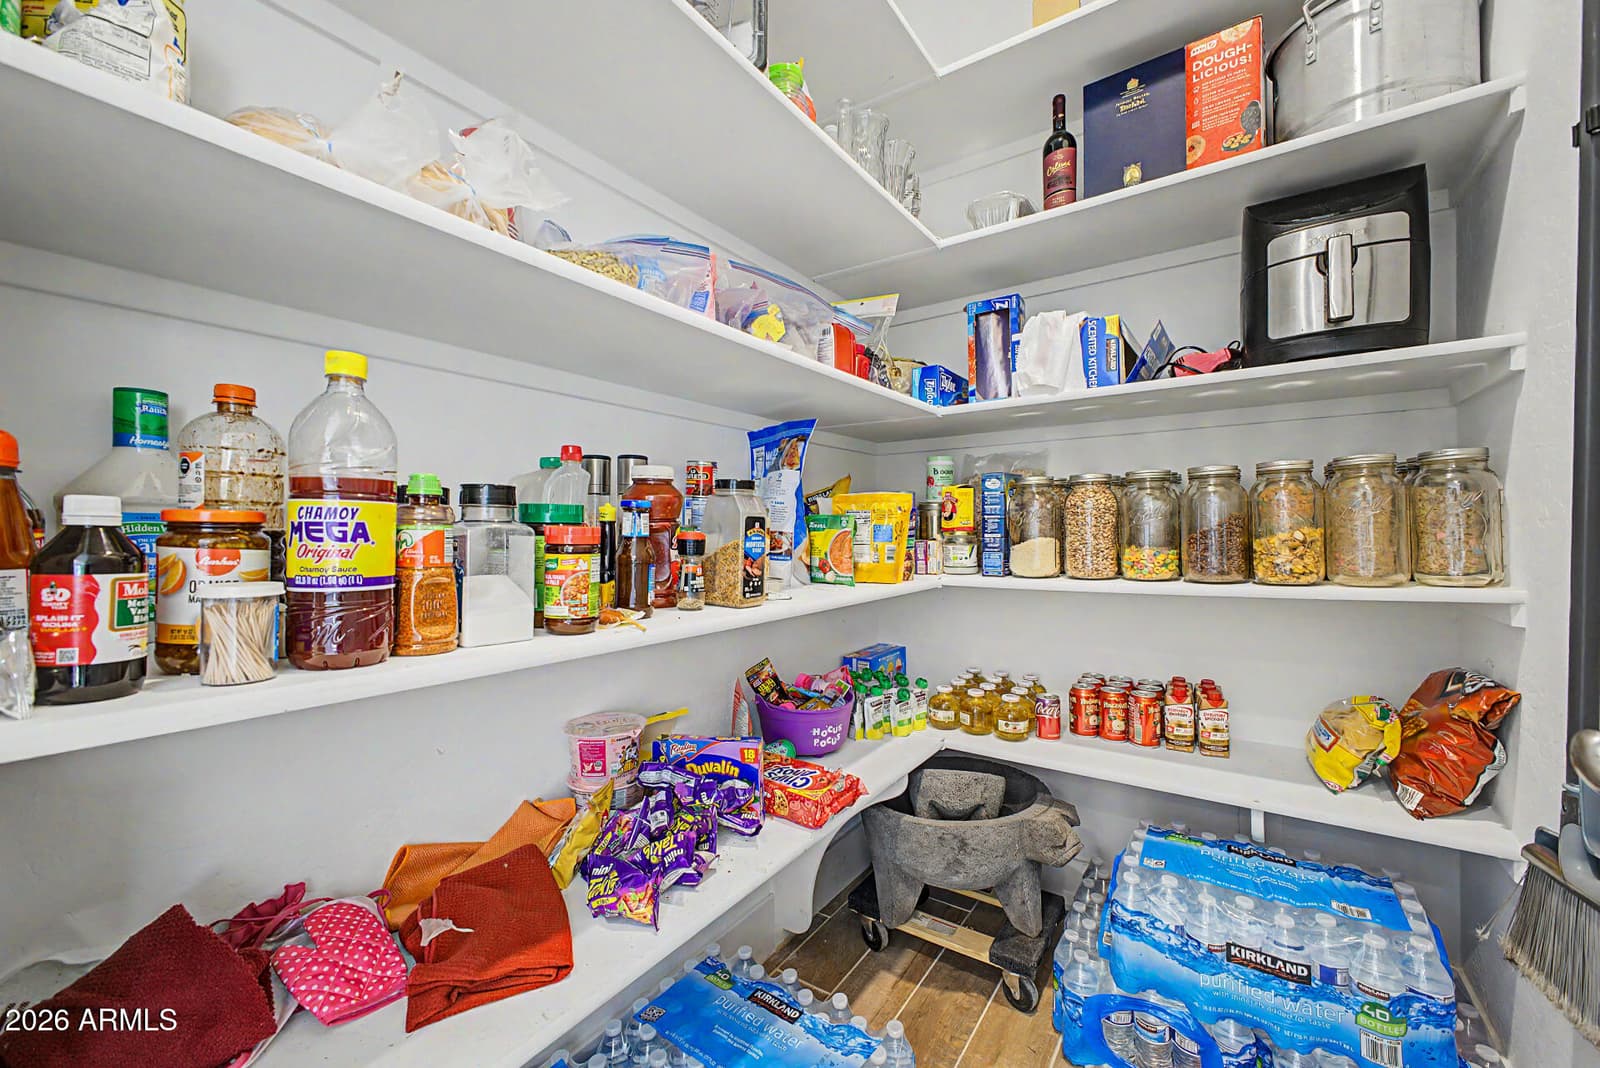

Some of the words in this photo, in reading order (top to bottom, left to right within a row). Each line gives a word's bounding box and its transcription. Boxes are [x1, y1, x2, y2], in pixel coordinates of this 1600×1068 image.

[1192, 42, 1253, 72] DOUGH-
[1192, 53, 1253, 83] LICIOUS!
[1087, 320, 1097, 356] SCENTED
[297, 506, 359, 520] CHAMOY
[120, 523, 159, 534] Hidden
[288, 520, 371, 548] MEGA
[296, 543, 360, 564] Original
[299, 566, 329, 574] Chamoy
[331, 565, 358, 573] Sauce
[812, 723, 843, 737] HOCUS
[813, 733, 841, 748] POCUS
[743, 749, 756, 759] 18
[685, 759, 740, 777] Duvalin
[1230, 845, 1295, 864] KIRKLAND
[591, 863, 614, 876] mini
[1230, 946, 1308, 977] KIRKLAND
[753, 990, 800, 1019] KIRKLAND
[1200, 974, 1275, 1004] purified
[1281, 997, 1344, 1024] water
[713, 995, 765, 1027] purified
